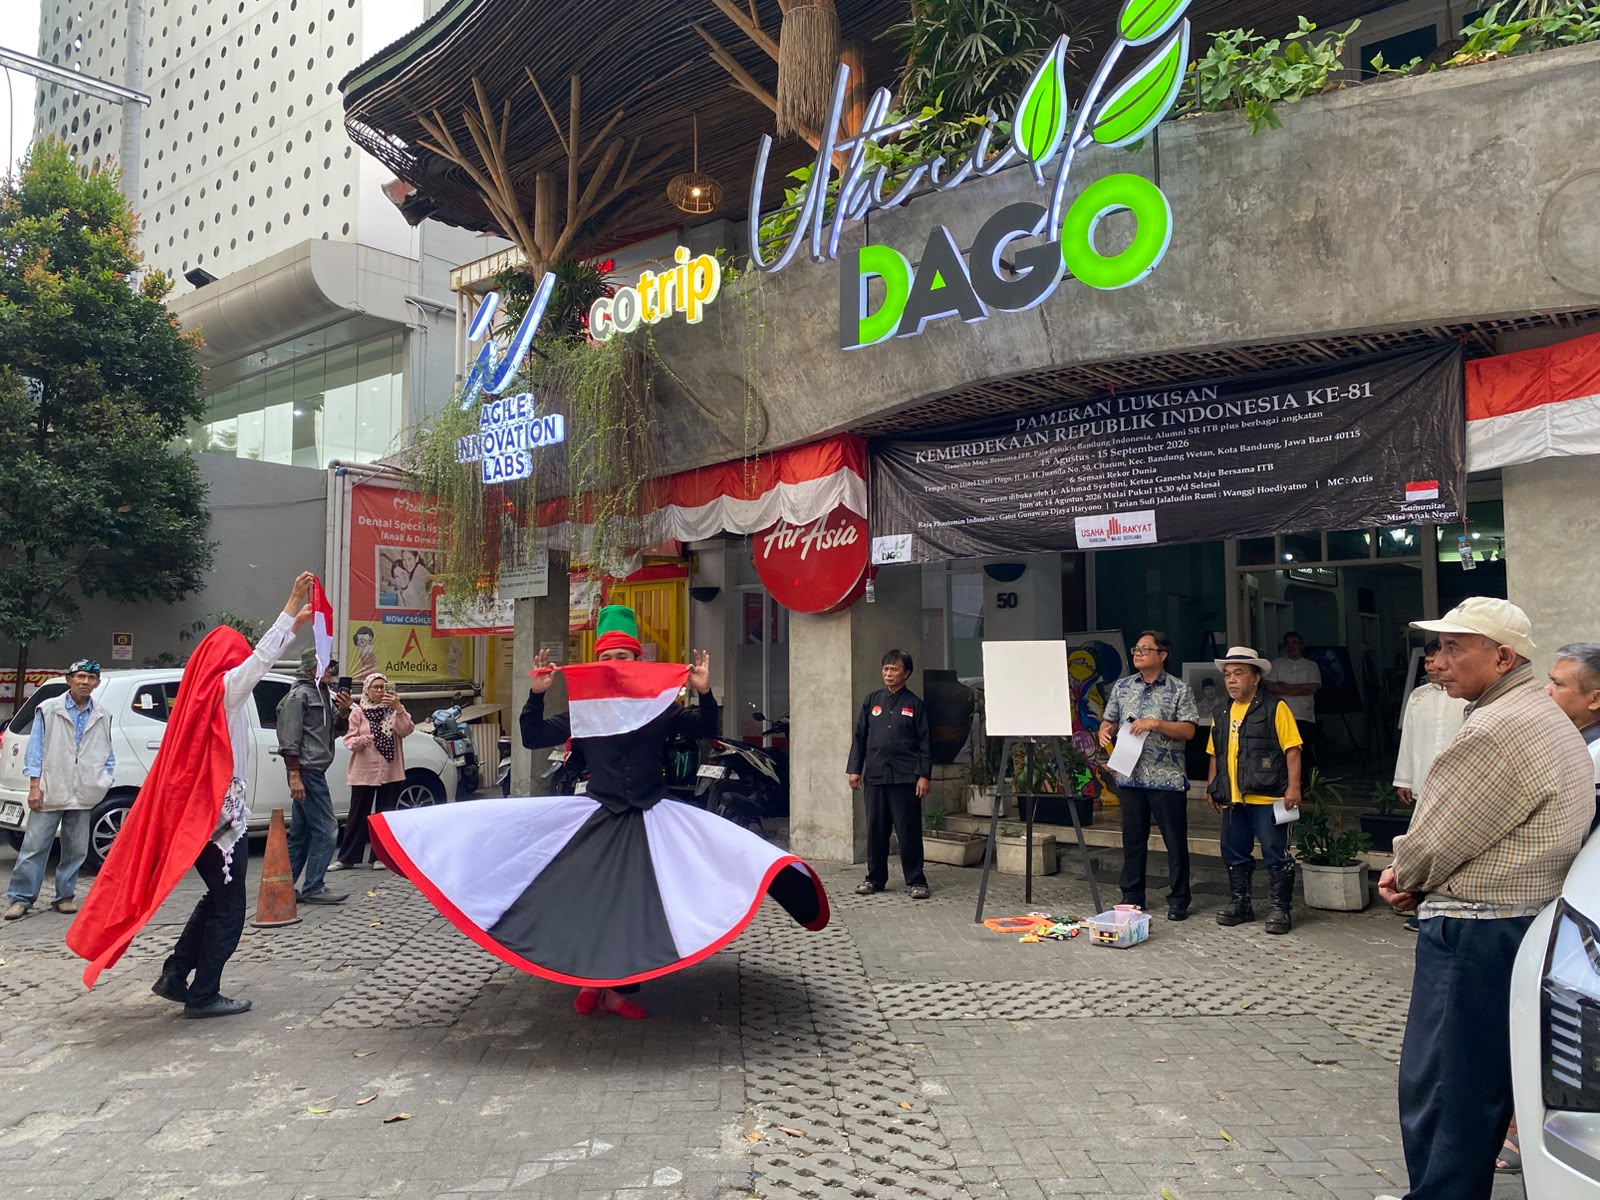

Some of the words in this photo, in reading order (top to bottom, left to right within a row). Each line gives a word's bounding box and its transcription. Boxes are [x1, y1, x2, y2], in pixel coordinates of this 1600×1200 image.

[840, 172, 1173, 351] DAGO
[589, 246, 720, 342] cotrip
[480, 393, 531, 426] AGILE
[915, 430, 1049, 463] KEMERDEKAAN
[1055, 412, 1156, 442] REPUBLIK
[1161, 393, 1300, 427] INDONESIA
[1306, 382, 1373, 407] KE-81
[1015, 401, 1112, 431] PAMERAN
[1118, 386, 1218, 413] LUKISAN
[1077, 440, 1111, 451] Bandung
[1112, 433, 1153, 445] Indonesia,
[1155, 428, 1186, 440] Alumni
[1188, 426, 1200, 436] SR
[1202, 424, 1218, 433] ITB
[1220, 422, 1239, 433] plus
[1241, 416, 1279, 428] berbagai
[1281, 411, 1323, 423] angkatan
[1041, 458, 1050, 466] 15
[1052, 454, 1090, 466] Agustus
[1097, 449, 1108, 459] 15
[1110, 441, 1165, 457] September
[1166, 439, 1190, 450] 2026
[1093, 459, 1127, 470] Citarum,
[1129, 457, 1146, 466] Kec.
[1147, 453, 1185, 464] Bandung
[1186, 449, 1215, 459] Wetan,
[1217, 445, 1238, 455] Kota
[1240, 440, 1281, 452] Bandung,
[1284, 438, 1306, 448] Jawa
[1308, 434, 1332, 444] Barat
[1334, 429, 1361, 441] 40115
[483, 452, 530, 482] LABS
[1077, 473, 1105, 483] Sensasi
[1107, 469, 1130, 479] Rekor
[1132, 467, 1157, 475] Dunia
[980, 495, 1008, 504] Pameran
[1009, 491, 1033, 501] dibuka
[1034, 489, 1049, 497] oleh
[1060, 484, 1092, 494] Akhmad
[1093, 479, 1128, 490] Syarbini,
[1130, 476, 1154, 486] Ketua
[1155, 472, 1191, 483] Ganesha
[1193, 469, 1216, 480] Maju
[1218, 465, 1255, 477] Bersama
[1257, 463, 1274, 472] ITB
[1045, 498, 1053, 506] 14
[1054, 495, 1084, 506] Agustus
[1085, 493, 1101, 502] 2026
[1103, 490, 1127, 500] Mulai
[1128, 487, 1152, 497] Pukul
[1154, 484, 1175, 494] 15.30
[1176, 482, 1189, 493] s/d
[1190, 479, 1221, 490] Selesai
[966, 515, 995, 524] Indonesia
[1017, 509, 1048, 519] Gunawan
[1050, 506, 1070, 516] Djaya
[1071, 503, 1102, 513] Haryono
[1113, 499, 1138, 508] Tarian
[1139, 497, 1155, 505] Sufi
[1156, 493, 1193, 505] Jalaludin
[1194, 490, 1217, 500] Rumi
[1223, 486, 1255, 498] Wanggi
[1256, 481, 1308, 494] Hoediyatno
[1327, 477, 1345, 486] MC
[1350, 474, 1374, 484] Artis
[1400, 502, 1446, 513] Komunitas
[358, 515, 392, 528] Dental
[1386, 512, 1406, 521] Misi
[1407, 511, 1430, 521] Anak
[1431, 509, 1459, 520] Negeri
[1081, 528, 1105, 538] USAHA
[1122, 523, 1152, 534] RAKYAT
[997, 592, 1018, 609] 50
[385, 615, 404, 624] NOW
[385, 661, 438, 672] AdMedika
